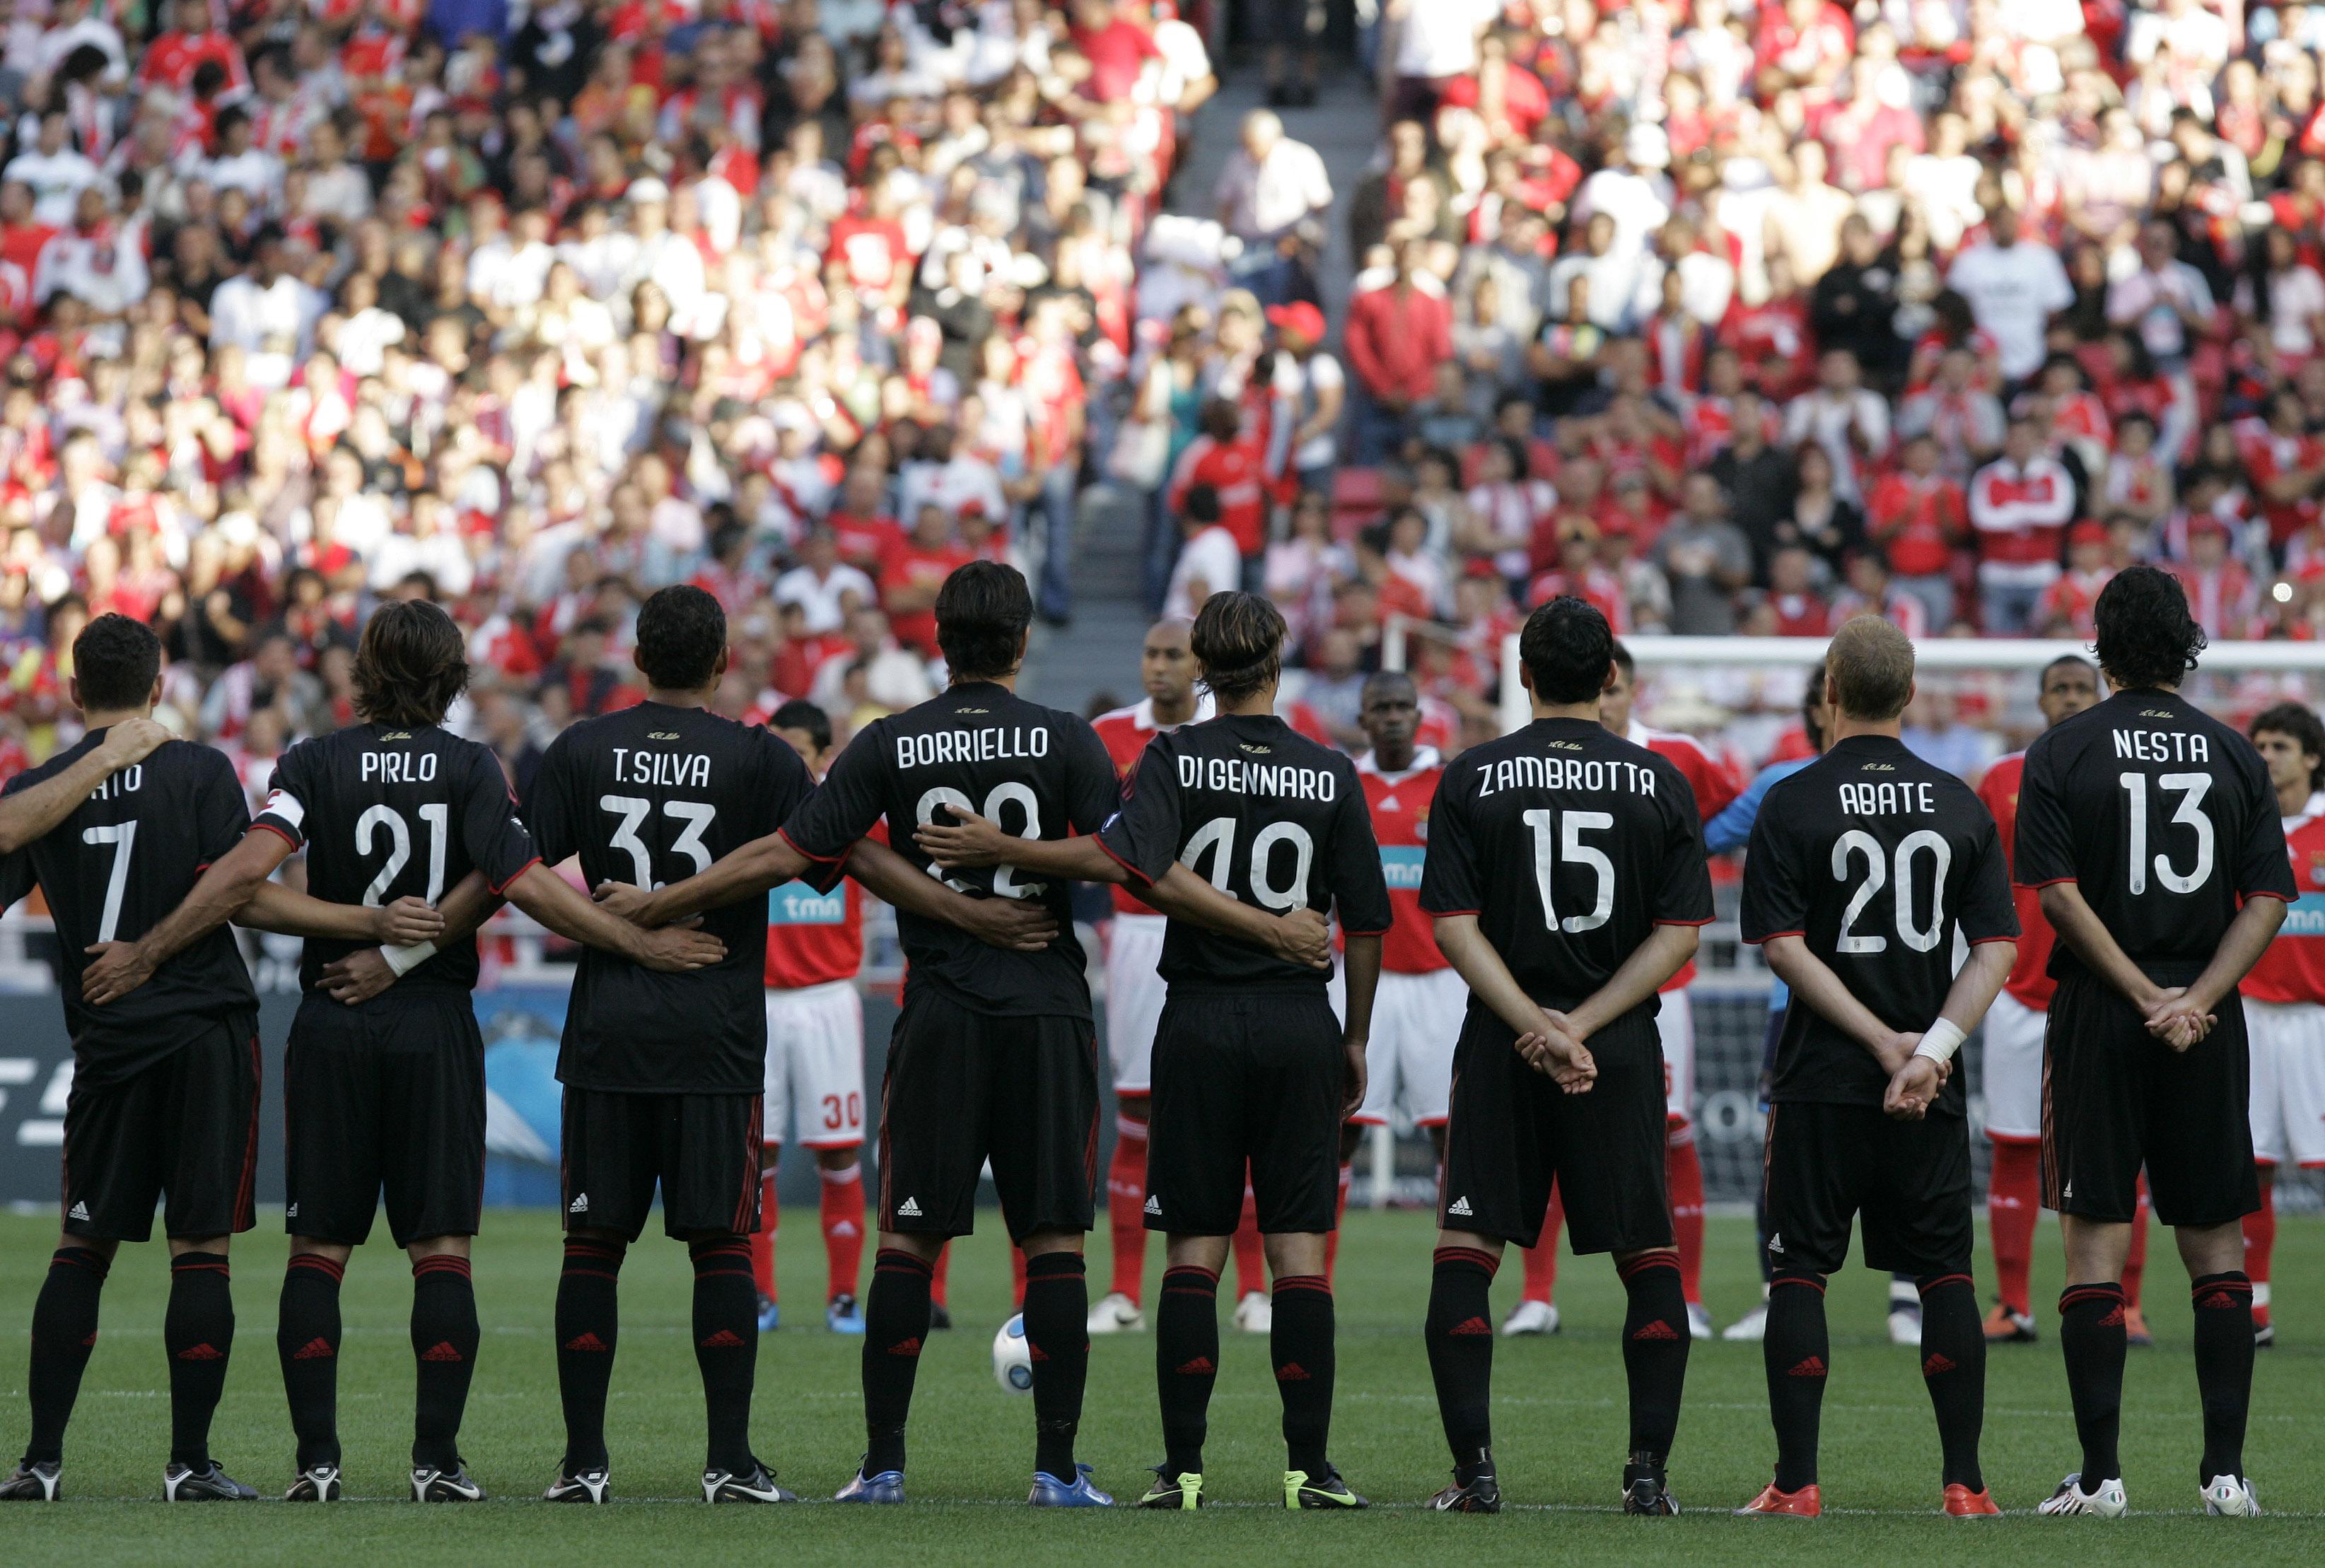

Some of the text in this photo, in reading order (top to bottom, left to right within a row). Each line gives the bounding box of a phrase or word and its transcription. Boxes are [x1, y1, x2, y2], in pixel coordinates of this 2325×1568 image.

[361, 751, 437, 783] PIRLO
[897, 727, 1047, 769] BORRIELLO
[2112, 730, 2208, 763] NESTA
[1209, 758, 1335, 802] GENNARO
[1477, 757, 1655, 798] ZAMBROTTA
[1839, 783, 1935, 816] ABATE
[600, 795, 716, 894] 33
[2119, 772, 2215, 896] 13
[355, 803, 448, 910] 21
[1179, 817, 1314, 913] 49
[1383, 862, 1423, 882] mn
[1522, 809, 1615, 934] 15
[82, 819, 138, 944] 7
[1831, 829, 1952, 953] 20
[783, 896, 841, 919] tmn
[2283, 910, 2325, 930] mn
[823, 1092, 859, 1130] 30
